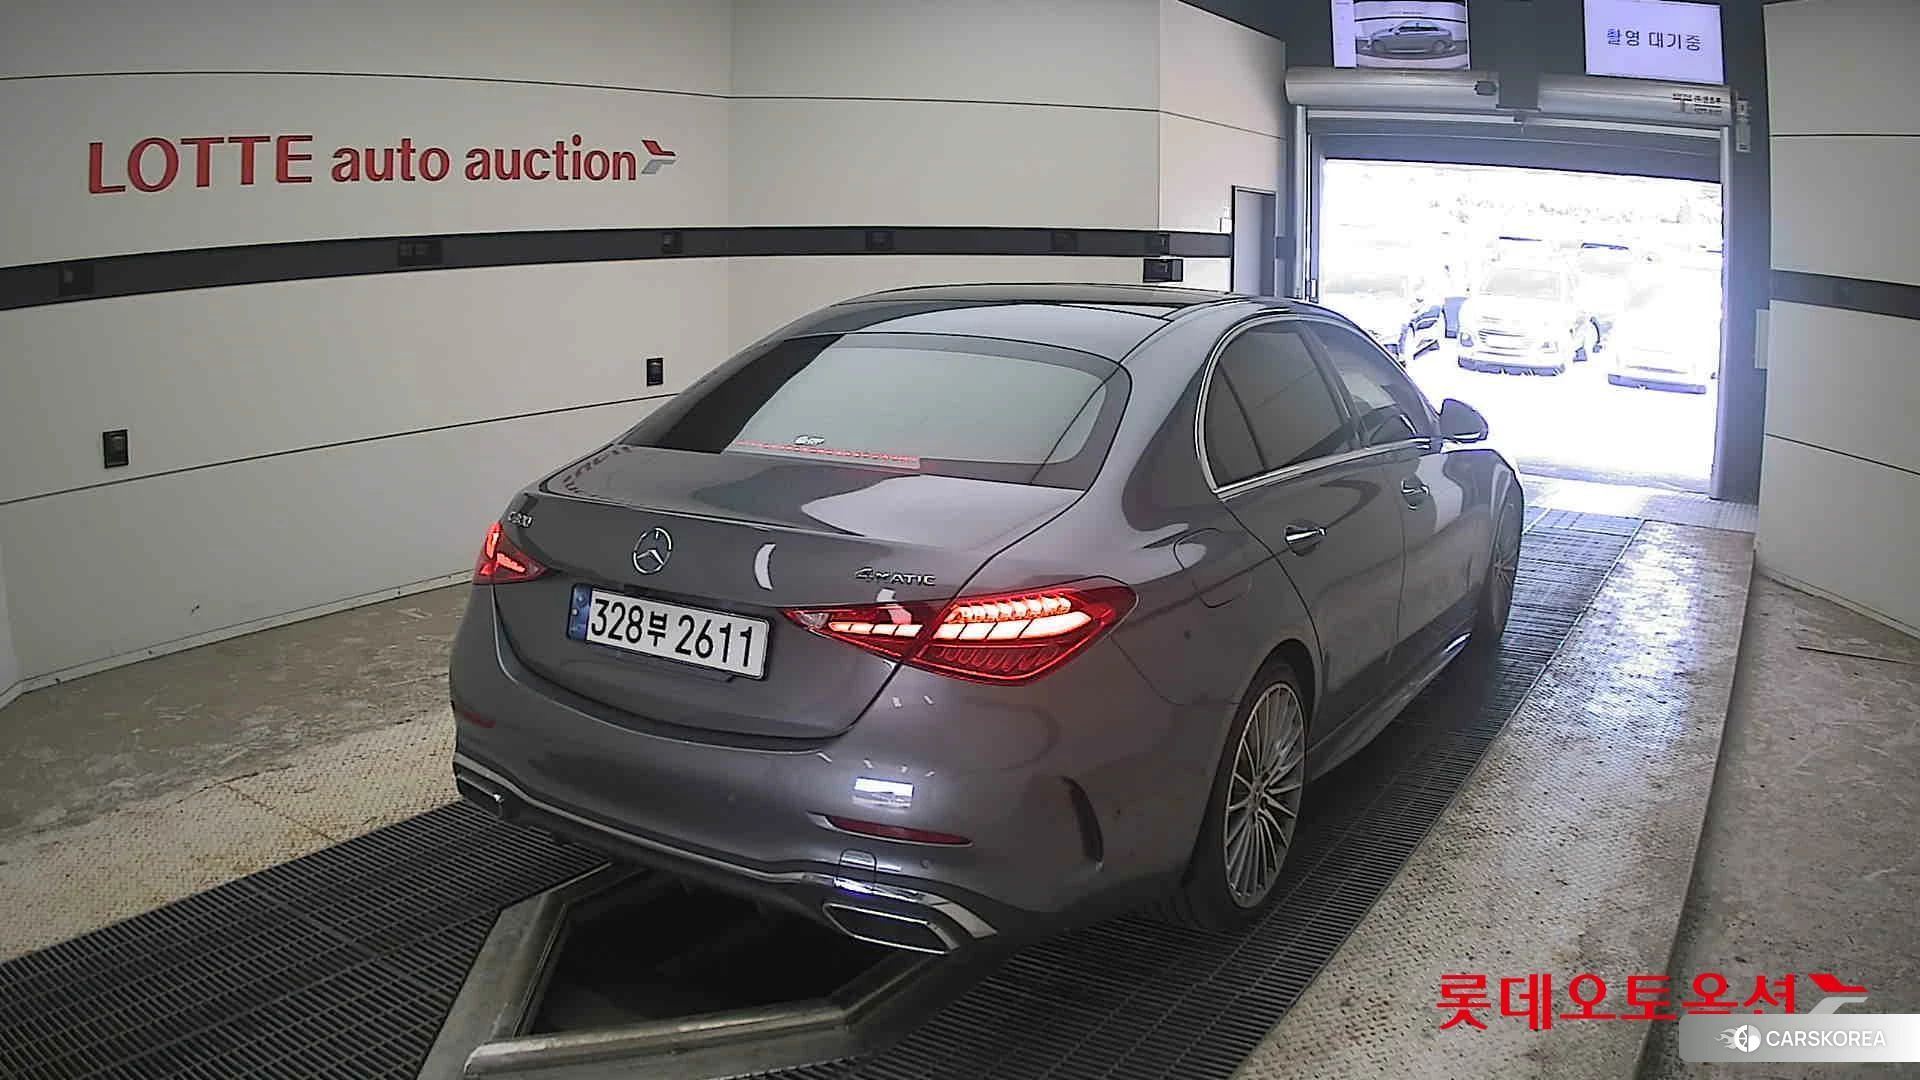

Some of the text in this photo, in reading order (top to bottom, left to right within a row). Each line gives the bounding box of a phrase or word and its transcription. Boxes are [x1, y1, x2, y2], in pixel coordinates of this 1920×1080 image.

[1648, 31, 1701, 52] 대기중
[88, 134, 638, 194] LOTTE auto auction
[855, 567, 937, 587] 4MATIC
[591, 598, 753, 668] 328부 2611
